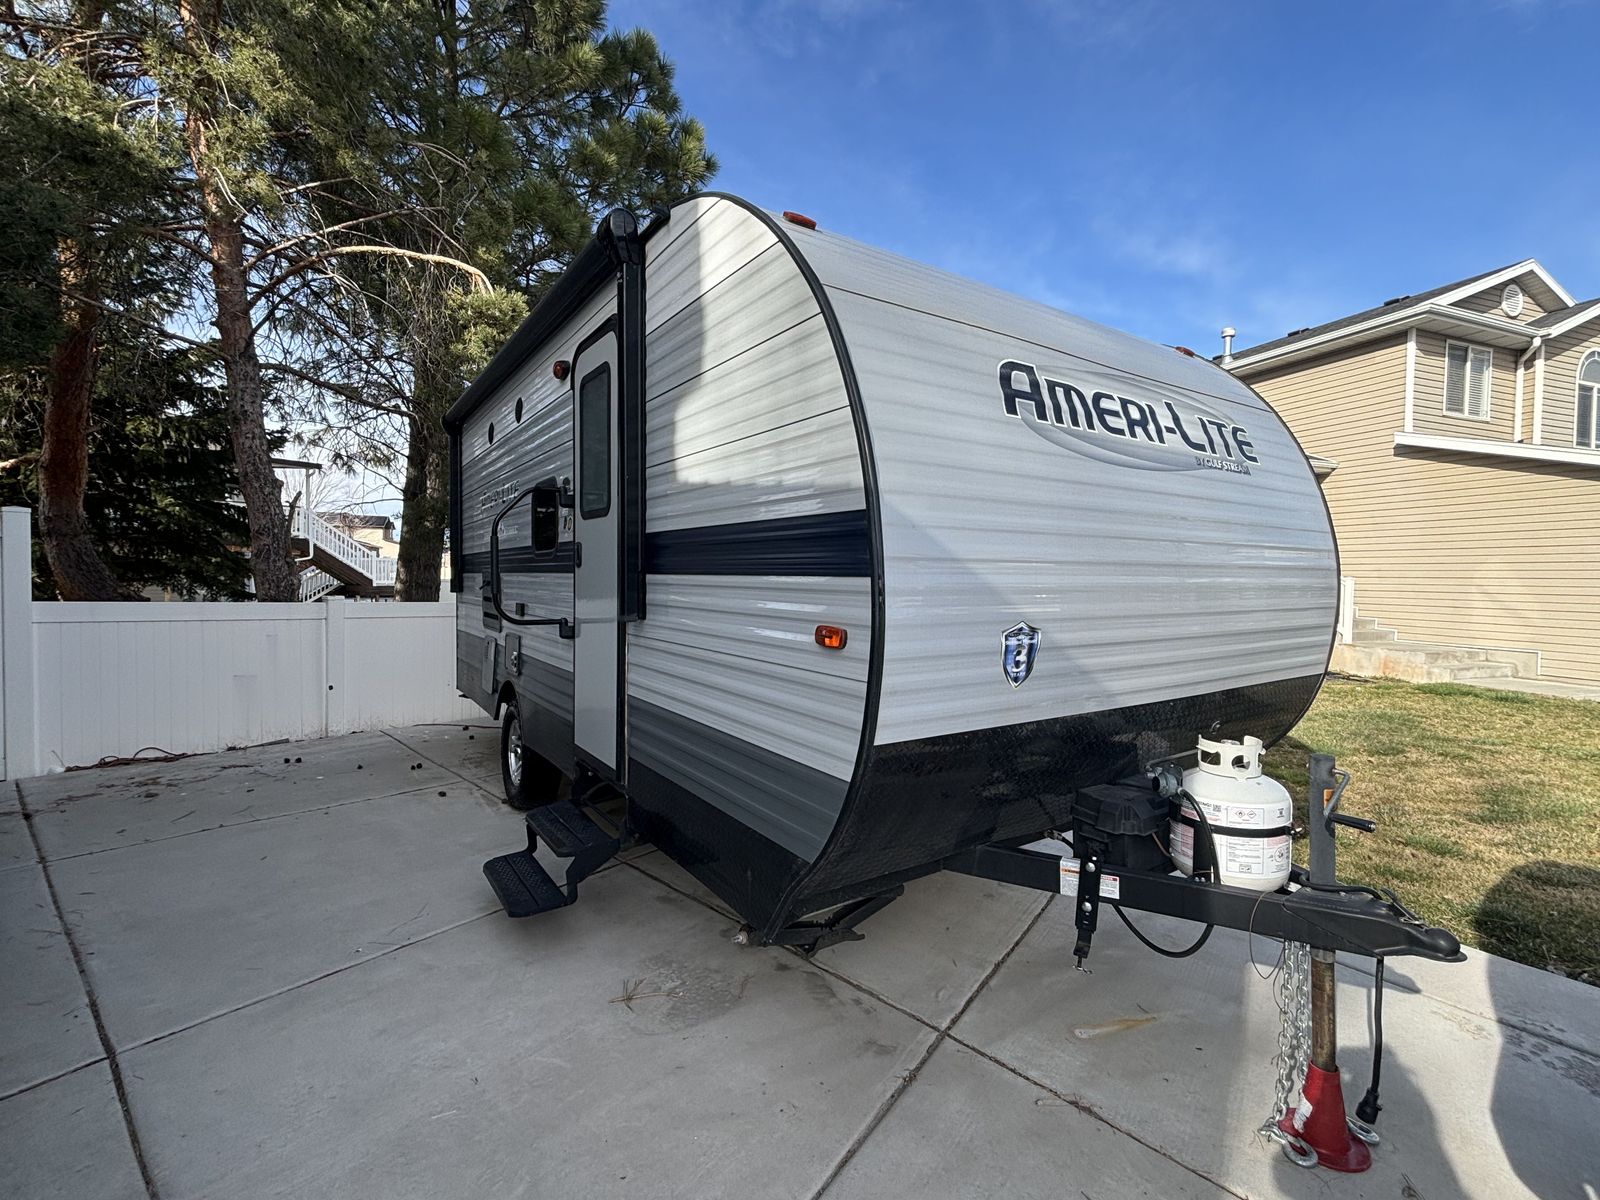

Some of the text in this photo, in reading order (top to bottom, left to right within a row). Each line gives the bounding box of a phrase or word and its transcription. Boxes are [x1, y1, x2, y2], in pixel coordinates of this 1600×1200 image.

[997, 359, 1260, 465] AMERI-LITE
[1205, 457, 1222, 469] GULF
[1222, 460, 1252, 476] STREAM
